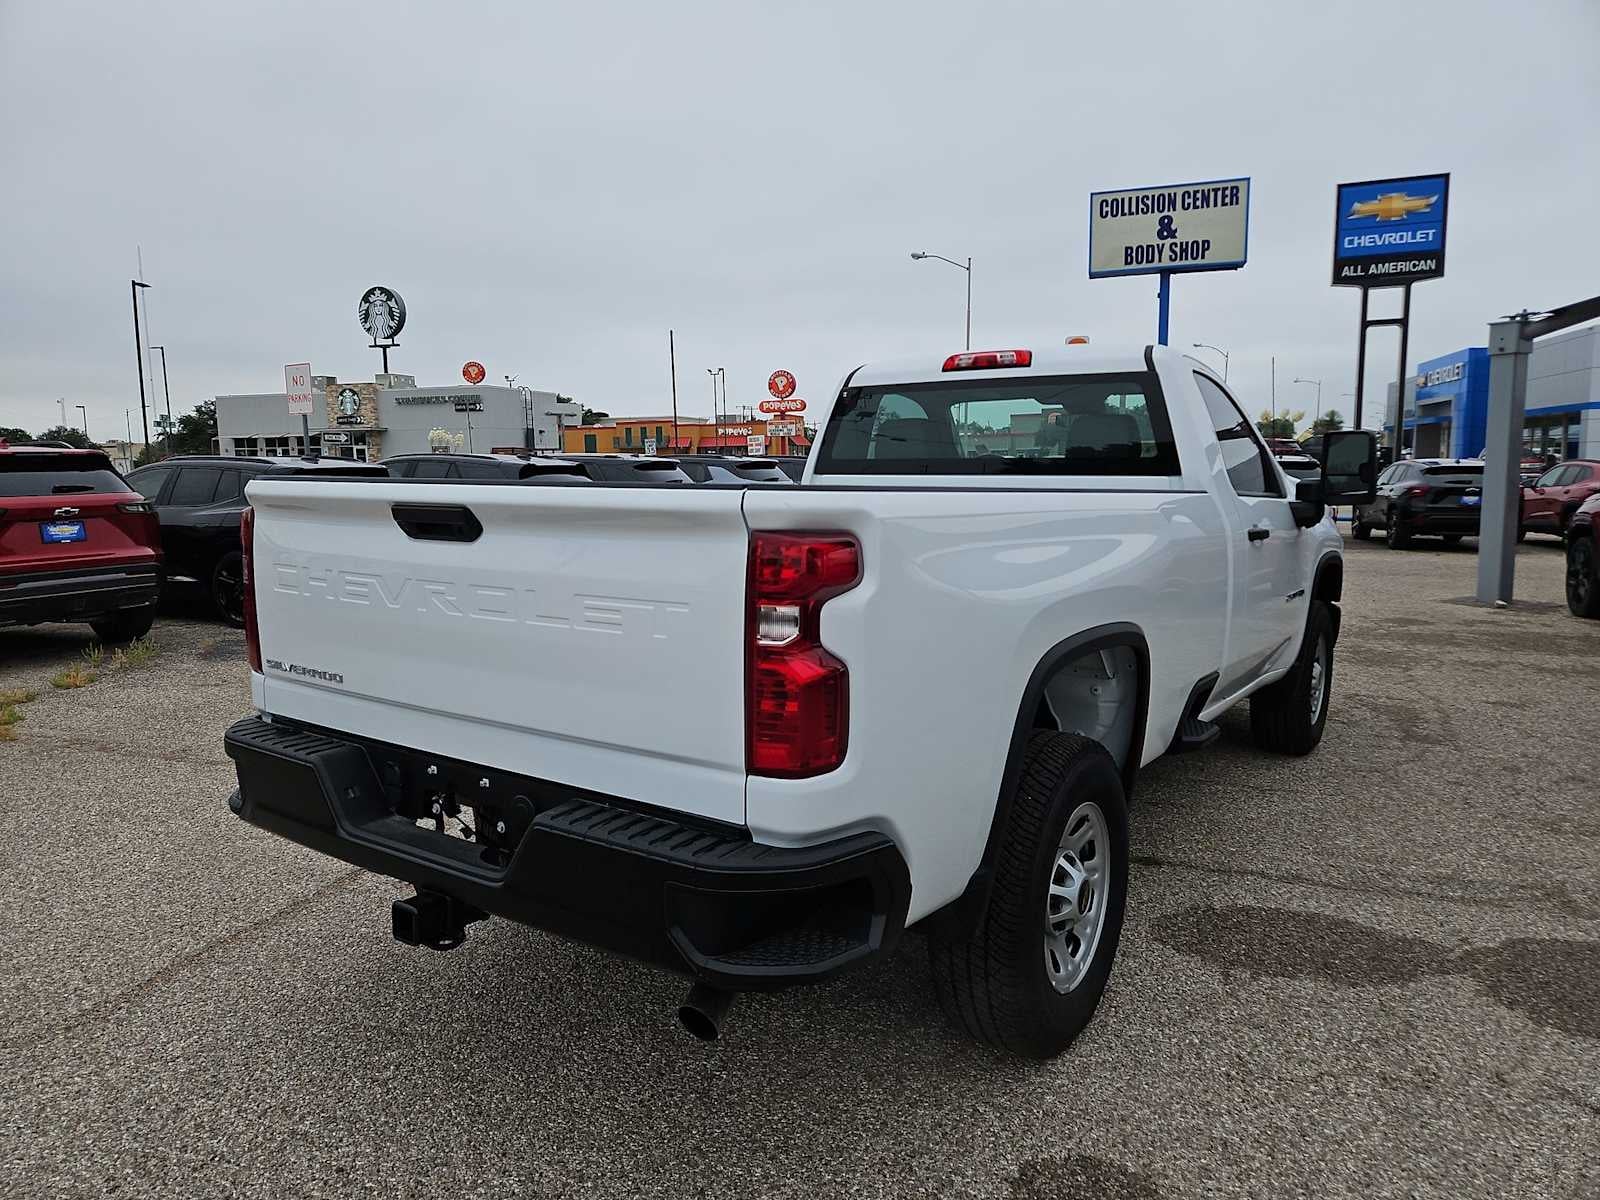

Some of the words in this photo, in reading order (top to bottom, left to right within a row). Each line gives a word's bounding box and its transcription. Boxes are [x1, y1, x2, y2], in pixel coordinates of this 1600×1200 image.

[1099, 191, 1178, 219] COLLISION
[1181, 185, 1241, 212] CENTER
[1156, 214, 1178, 241] &
[1343, 229, 1436, 249] CHEVROLET
[1124, 241, 1165, 266] BODY
[1168, 239, 1211, 263] SHOP
[1341, 262, 1365, 277] ALL
[1367, 259, 1437, 275] AMERICAN
[292, 375, 304, 387] NO
[775, 376, 788, 391] P
[1428, 362, 1465, 387] CHEVROLET
[288, 392, 312, 404] PARKING
[763, 400, 802, 411] POPEYES
[272, 563, 690, 639] CHEVROLET
[266, 659, 343, 683] SILVERADO
